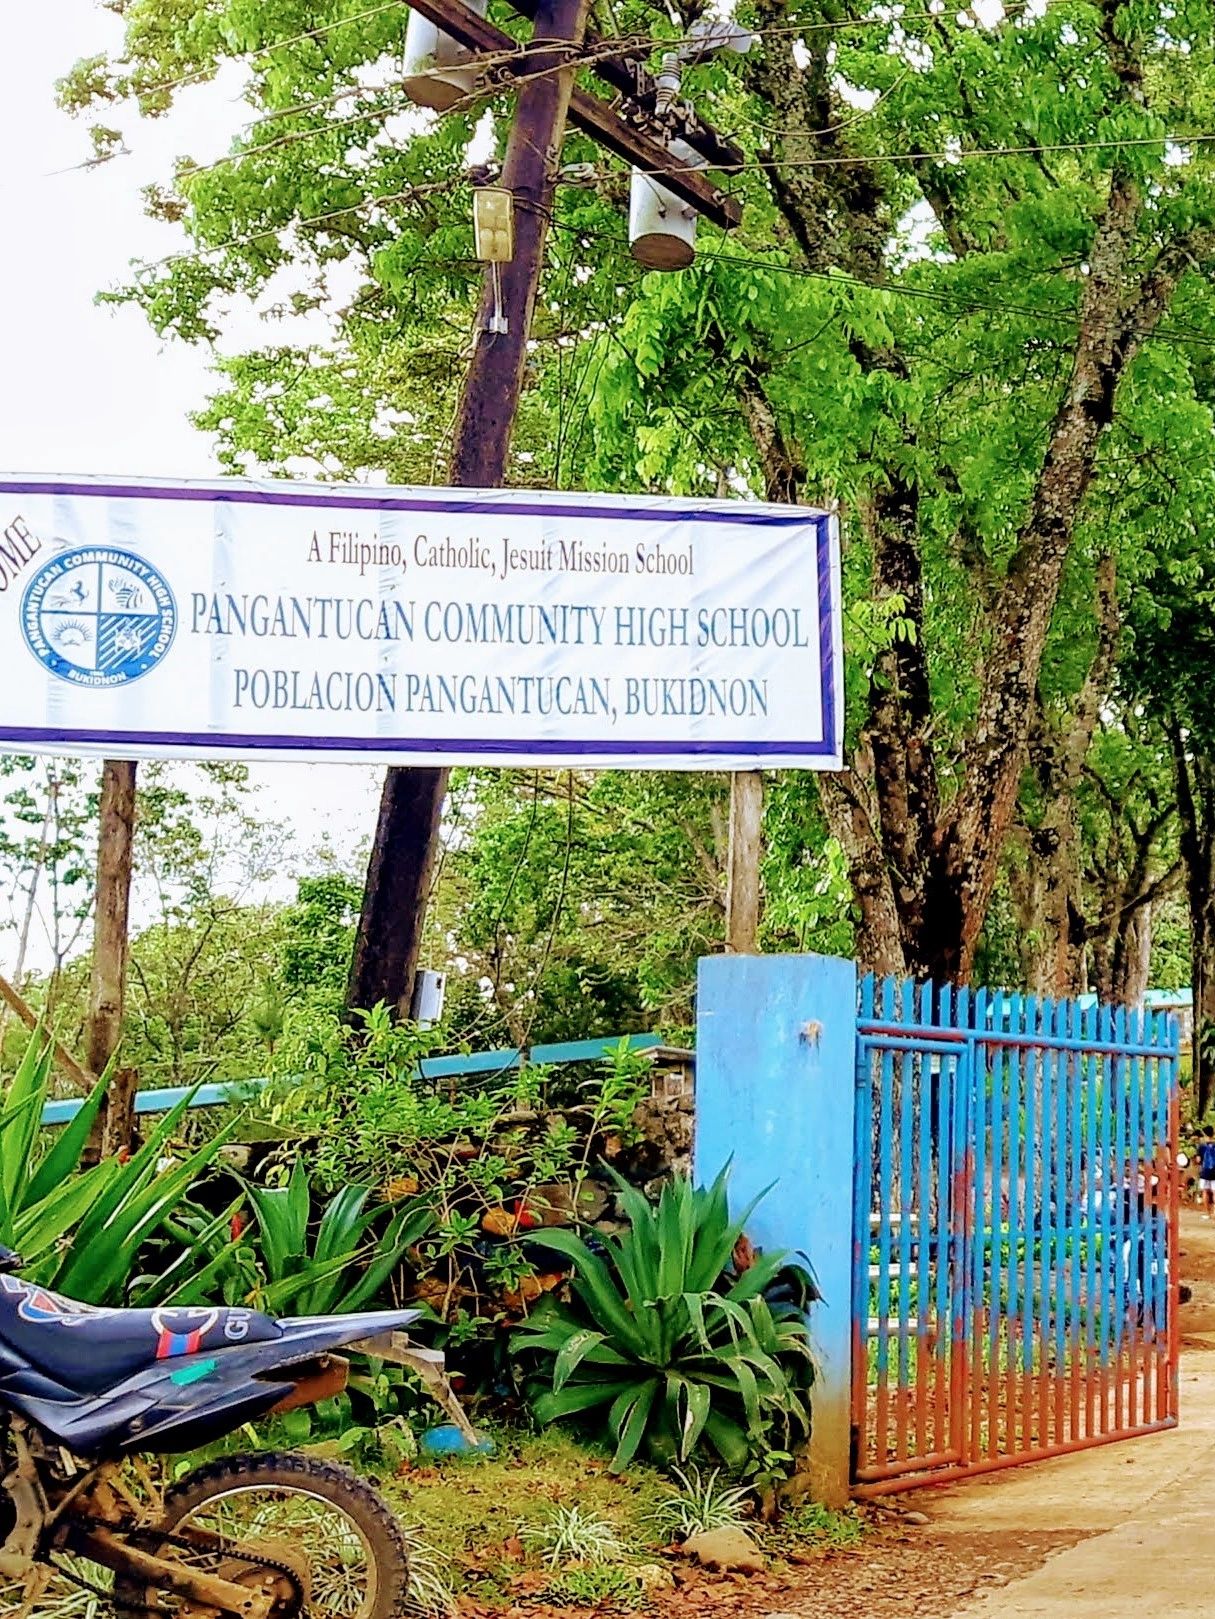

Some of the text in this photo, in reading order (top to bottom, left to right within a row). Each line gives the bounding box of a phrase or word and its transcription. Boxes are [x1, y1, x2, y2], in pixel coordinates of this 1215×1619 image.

[307, 531, 695, 580] A Filipino, Catholic, Jesuit Mission School
[26, 551, 174, 659] PANGANTUCAN COMMUNITY HIGH SCHOOL
[190, 593, 809, 649] PANGANTUCAN COMMUNITY HIGH SCHOOL
[68, 671, 127, 686] BUKIDNON
[234, 669, 769, 725] POBLACION PANGANTUCAN, BUKIDNON
